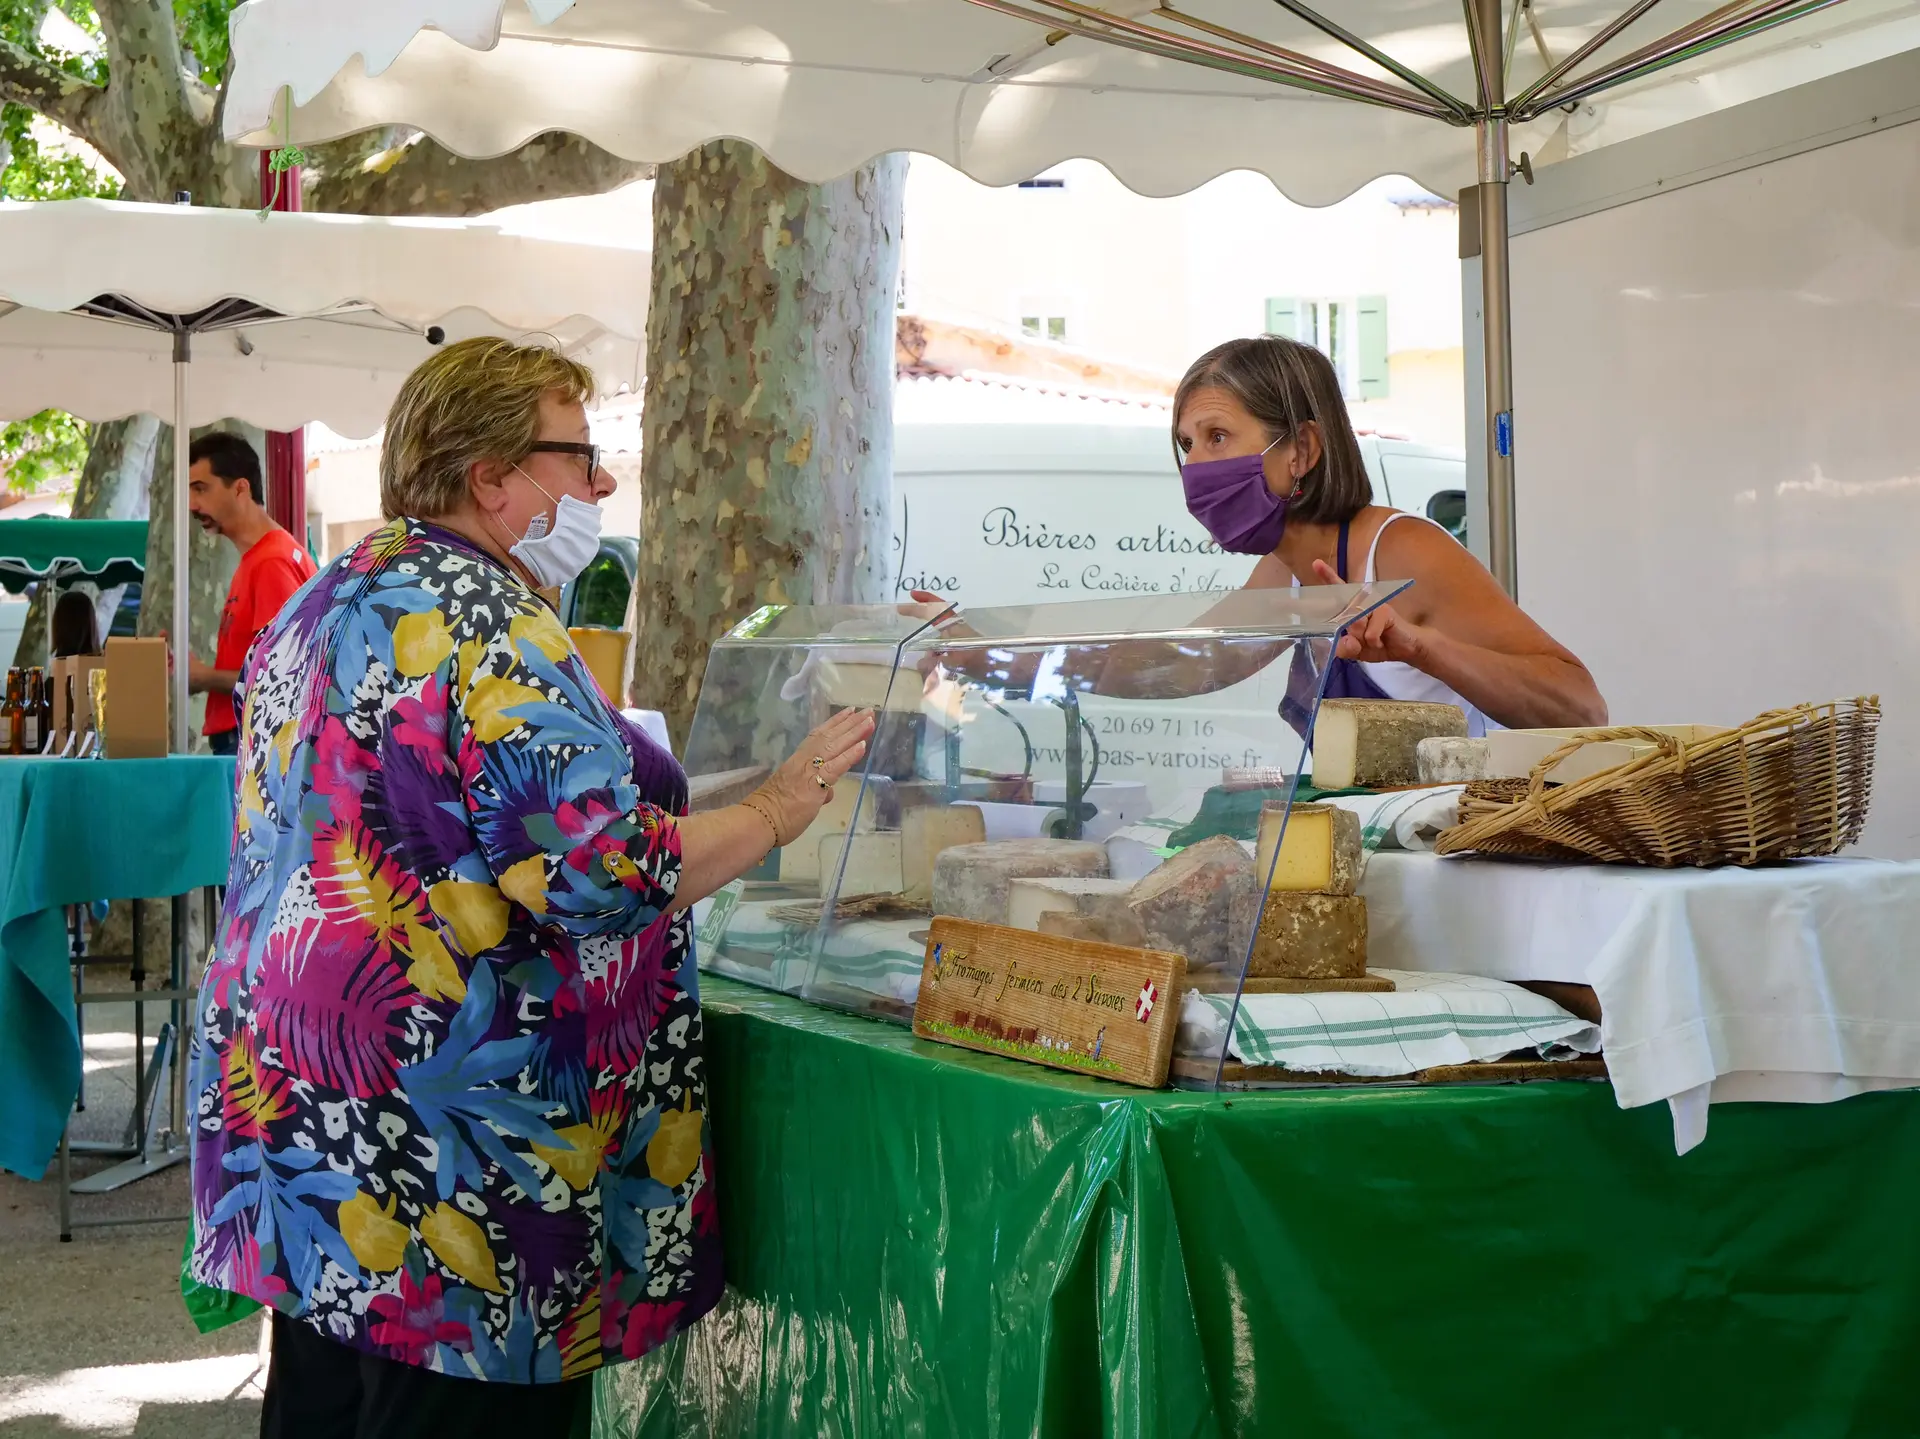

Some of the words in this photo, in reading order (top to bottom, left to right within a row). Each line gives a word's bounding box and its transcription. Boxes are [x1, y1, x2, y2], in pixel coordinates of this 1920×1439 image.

[982, 506, 1097, 550] Bières
[1115, 524, 1245, 556] artisa
[894, 571, 961, 592] oise
[1036, 562, 1072, 589] La
[1081, 564, 1161, 592] Cadière
[1102, 716, 1125, 734] 20
[1130, 717, 1154, 736] 69
[1161, 718, 1182, 737] 71
[1194, 719, 1215, 738] 16
[946, 953, 995, 998] Fromages
[995, 959, 1044, 1002] fermiers
[1050, 975, 1069, 999] des
[1071, 975, 1083, 1001] 2
[1085, 972, 1126, 1013] Savoies
